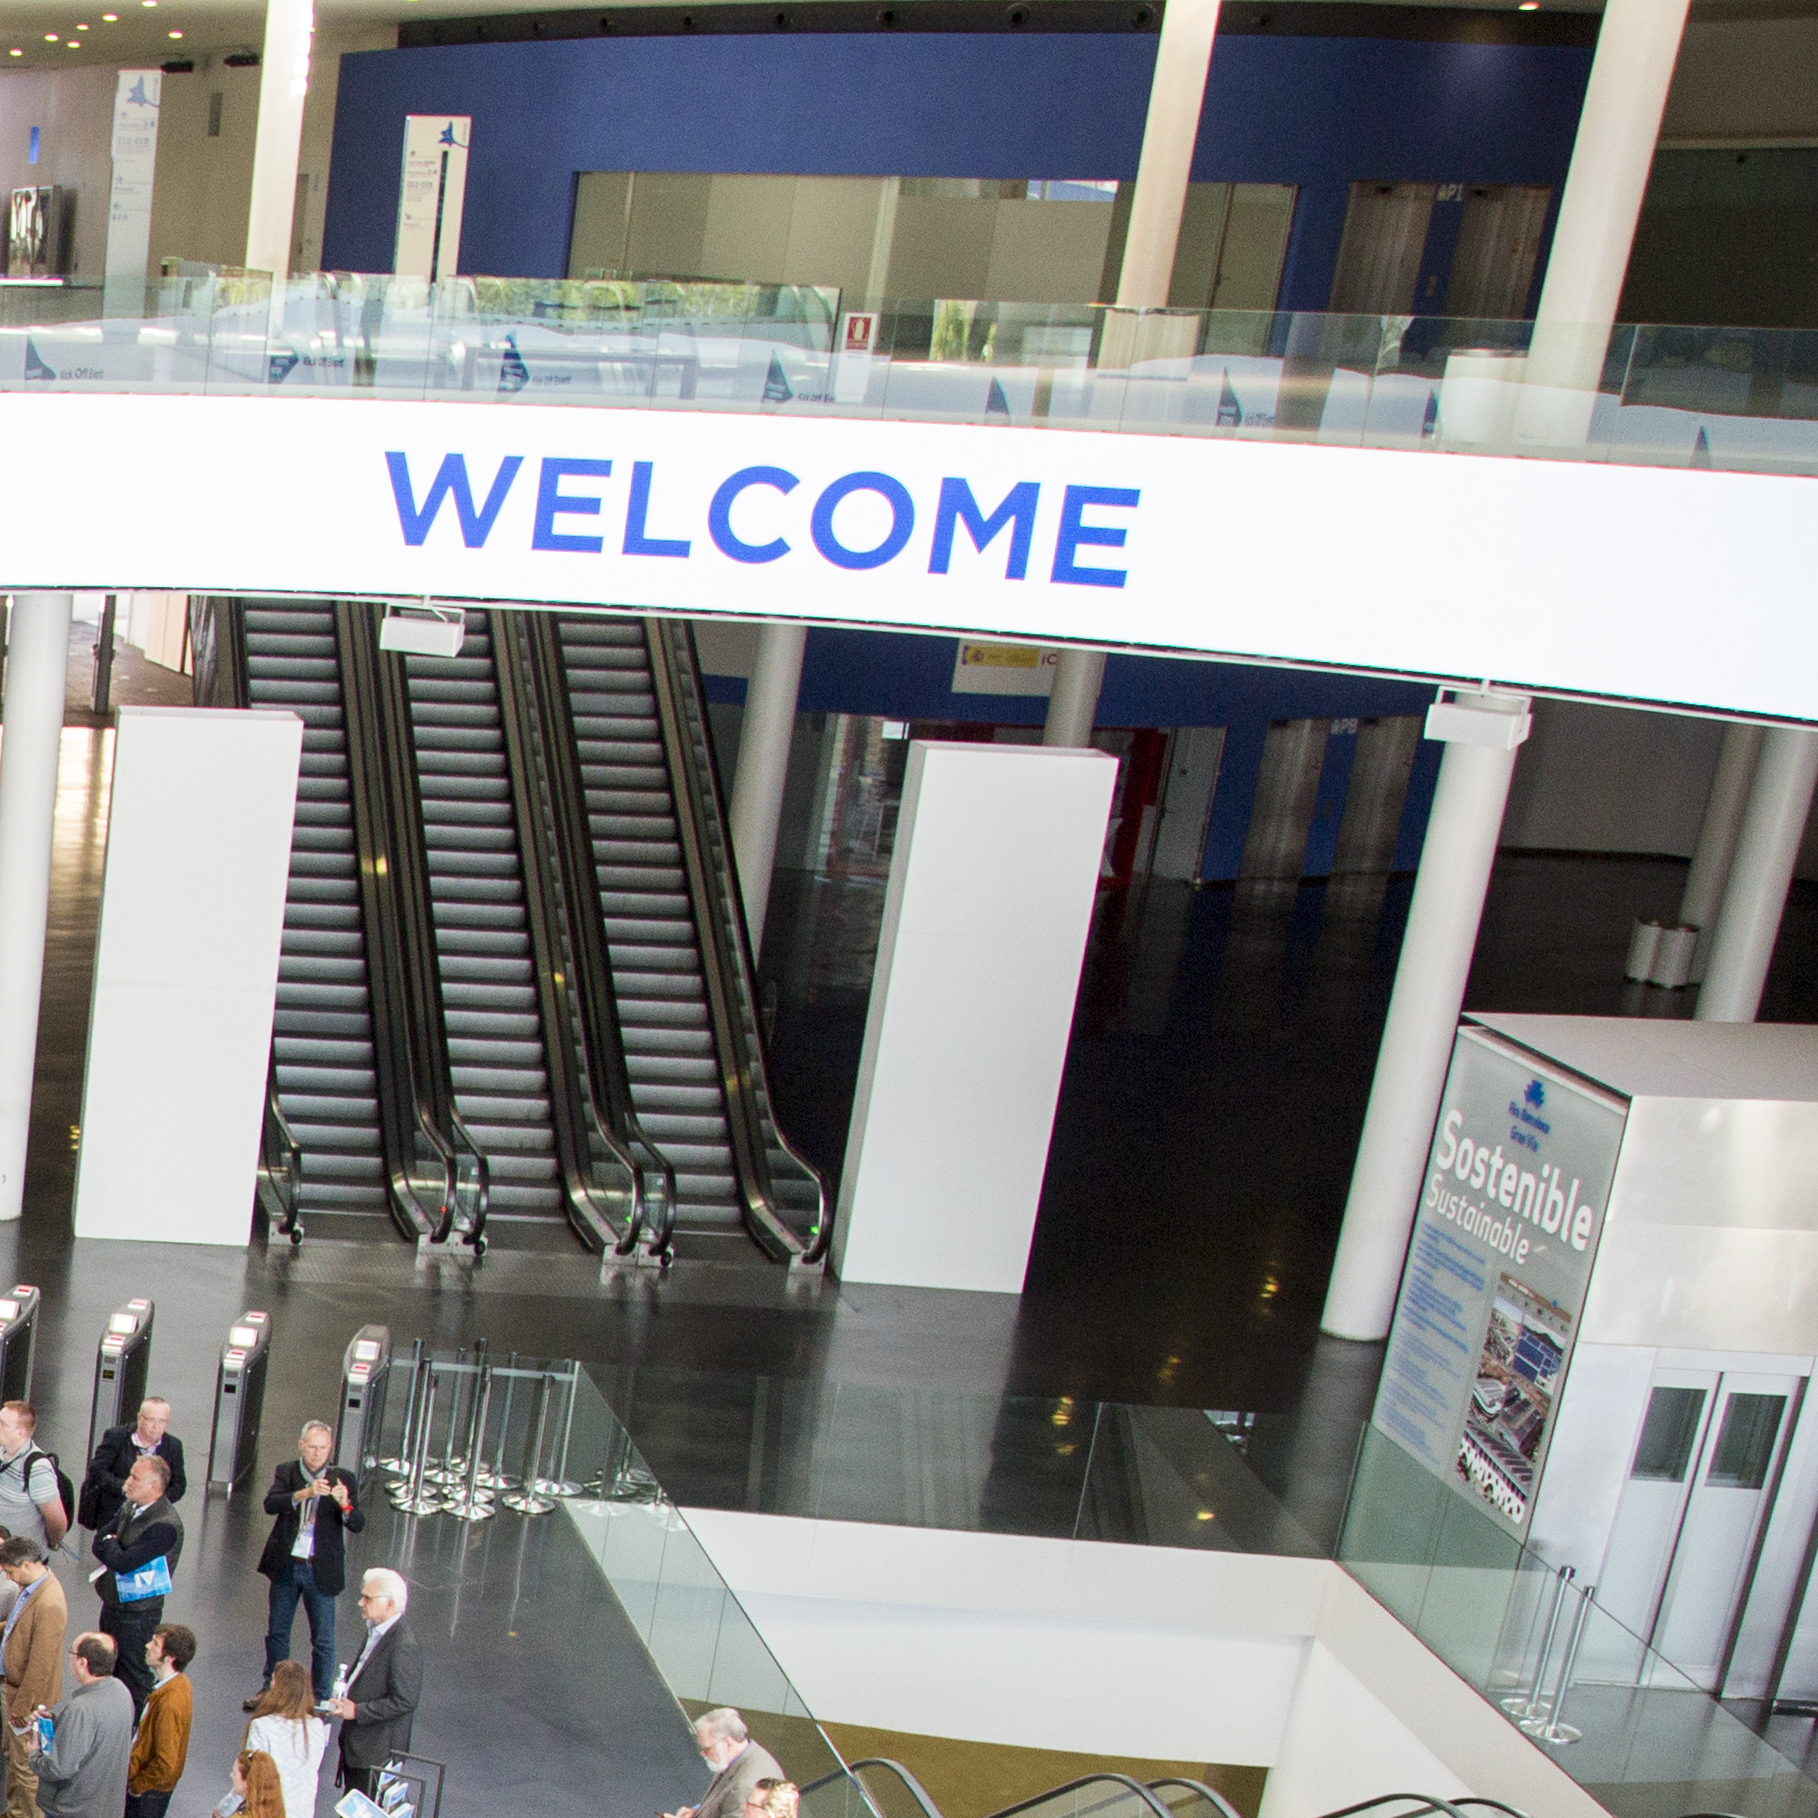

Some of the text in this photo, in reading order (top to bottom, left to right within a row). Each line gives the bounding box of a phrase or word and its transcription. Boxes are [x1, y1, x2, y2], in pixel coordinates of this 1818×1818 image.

[384, 451, 1142, 589] WELCOME
[1426, 1173, 1531, 1265] Sustainable
[1436, 1109, 1594, 1251] Sostenible
